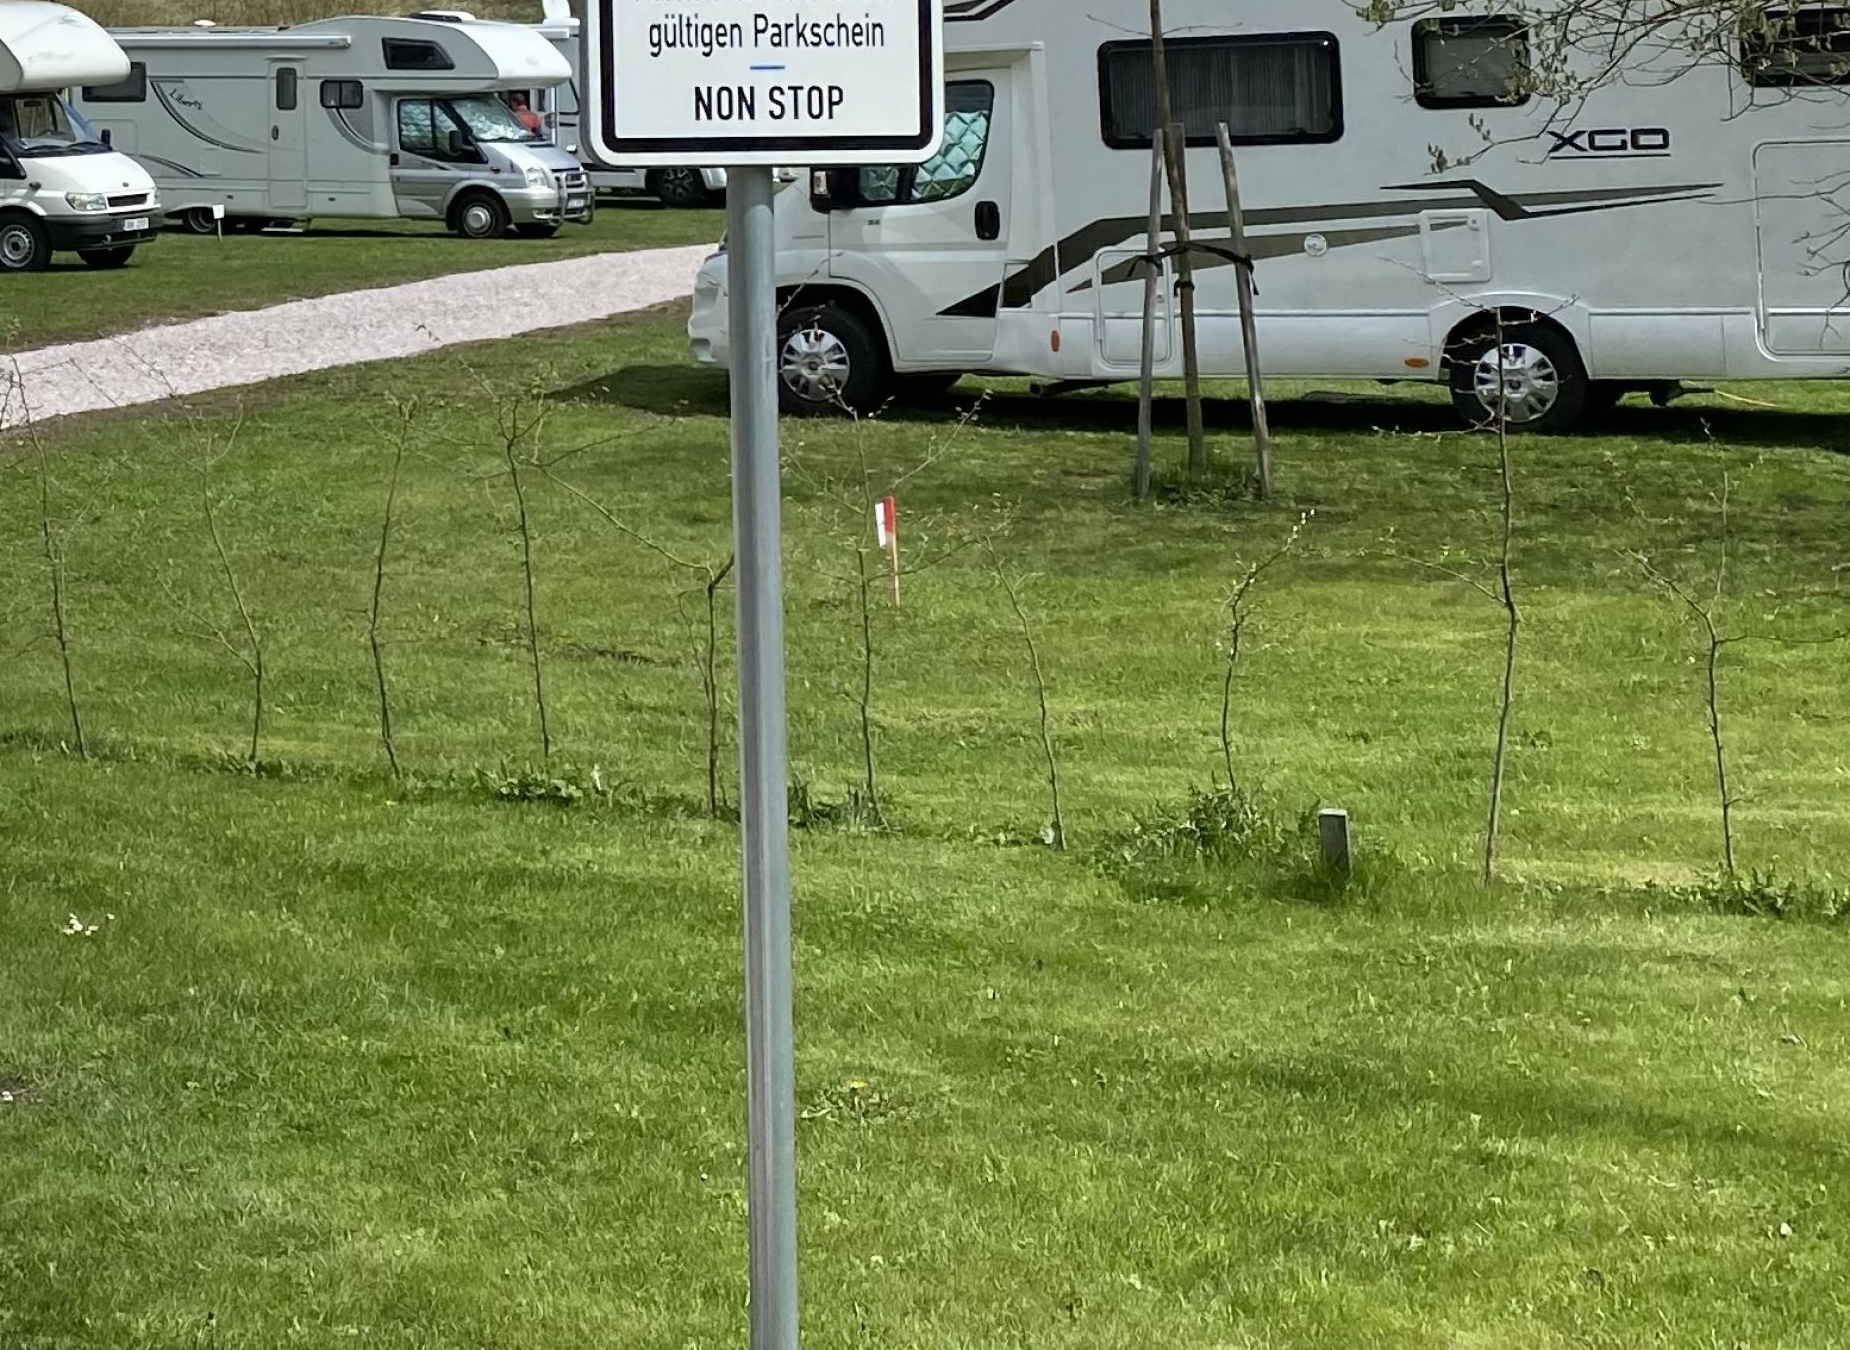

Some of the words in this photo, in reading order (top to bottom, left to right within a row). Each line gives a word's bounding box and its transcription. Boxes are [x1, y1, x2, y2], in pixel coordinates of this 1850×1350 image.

[649, 13, 743, 58] gültigen
[753, 12, 885, 48] Parkschein
[694, 85, 756, 121] NON
[768, 85, 844, 120] STOP
[1546, 128, 1670, 153] XGO
